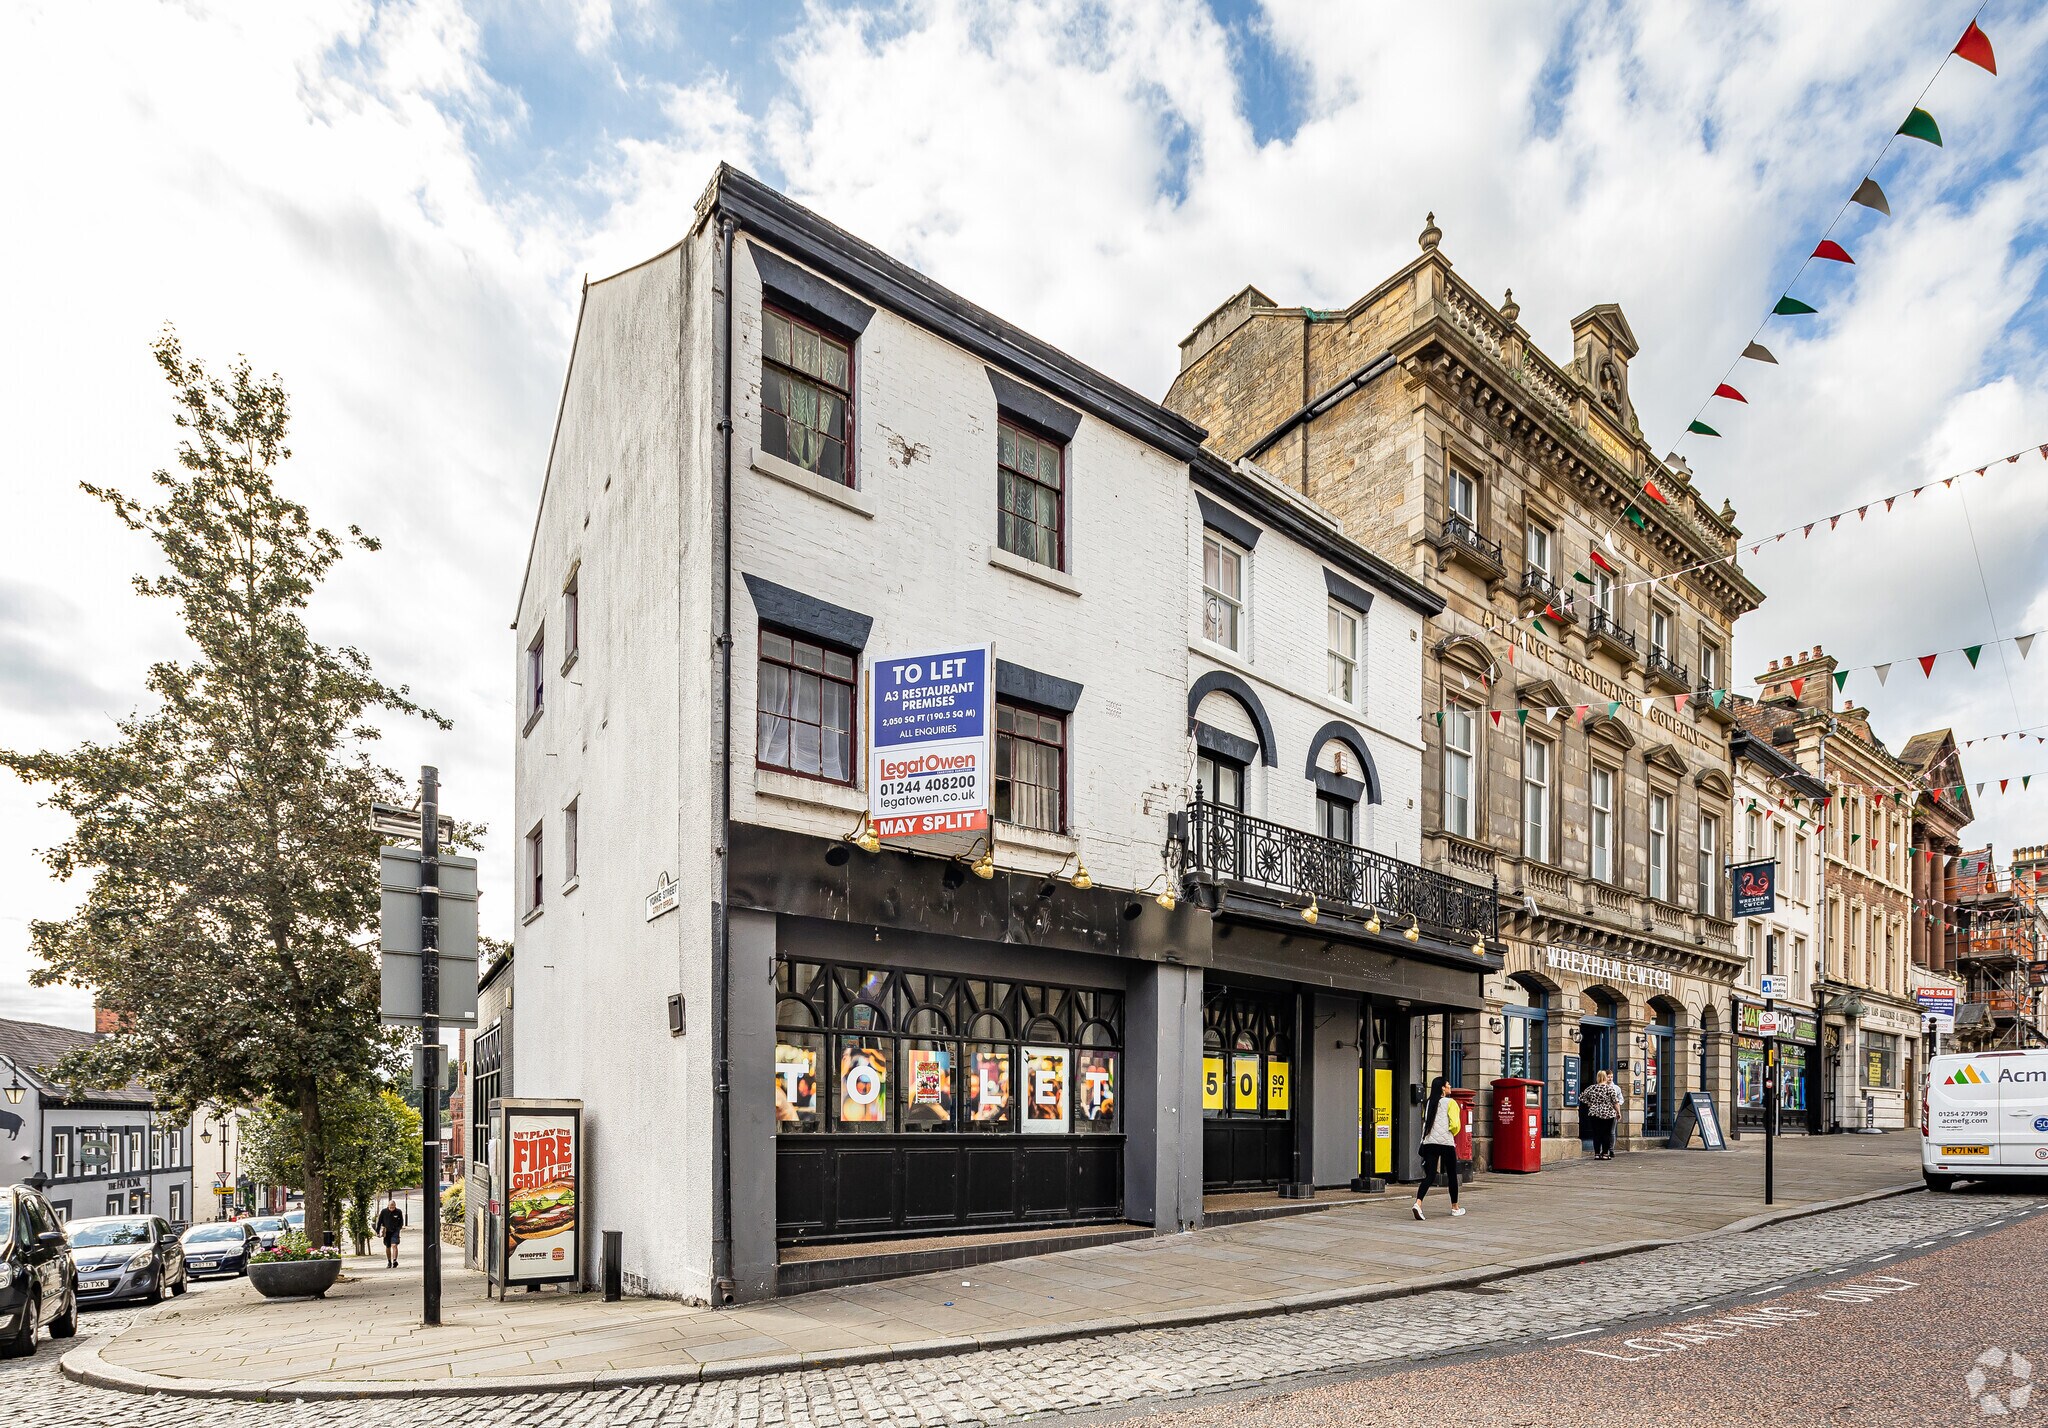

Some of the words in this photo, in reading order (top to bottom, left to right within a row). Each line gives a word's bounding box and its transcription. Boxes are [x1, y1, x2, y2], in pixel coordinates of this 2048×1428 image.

[893, 664, 923, 684] TO
[930, 658, 967, 680] LET
[1484, 610, 1554, 665] ALLIANCE
[1567, 662, 1641, 714] ASSURANCE
[1651, 708, 1700, 747] COMPANY
[884, 690, 899, 702] A3
[902, 682, 974, 699] RESTAURANT
[902, 696, 955, 711] PREMISES
[882, 716, 902, 727] 2,050
[904, 715, 915, 724] SQ
[917, 714, 926, 722] FT
[926, 712, 950, 723] (190.5
[952, 711, 963, 719] SQ
[965, 709, 976, 718] M)
[899, 729, 913, 738] ALL
[915, 724, 957, 736] ENQUIRIES
[881, 754, 976, 781] LegatOwen
[880, 779, 920, 796] 01244
[925, 775, 975, 792] 408200
[880, 789, 975, 809] legatowen.co.uk
[880, 818, 918, 835] MAY
[922, 813, 975, 831] SPLIT
[1547, 946, 1622, 980] WREXHAM
[1627, 963, 1671, 990] CWTCH
[1744, 1006, 1762, 1027] VAP
[1777, 1013, 1794, 1033] HOP
[1272, 1075, 1285, 1086] SQ
[1998, 1069, 2046, 1083] Acm
[1272, 1087, 1283, 1098] FT
[530, 1129, 556, 1139] PLAY
[513, 1135, 572, 1173] FIRE
[117, 1179, 125, 1189] FAT
[127, 1178, 141, 1188] BOAR
[513, 1166, 557, 1189] GRILL
[558, 1163, 572, 1171] WITH
[90, 1280, 105, 1288] TXK
[1577, 1307, 1820, 1362] LOADING
[1814, 1275, 1920, 1302] ONLY
